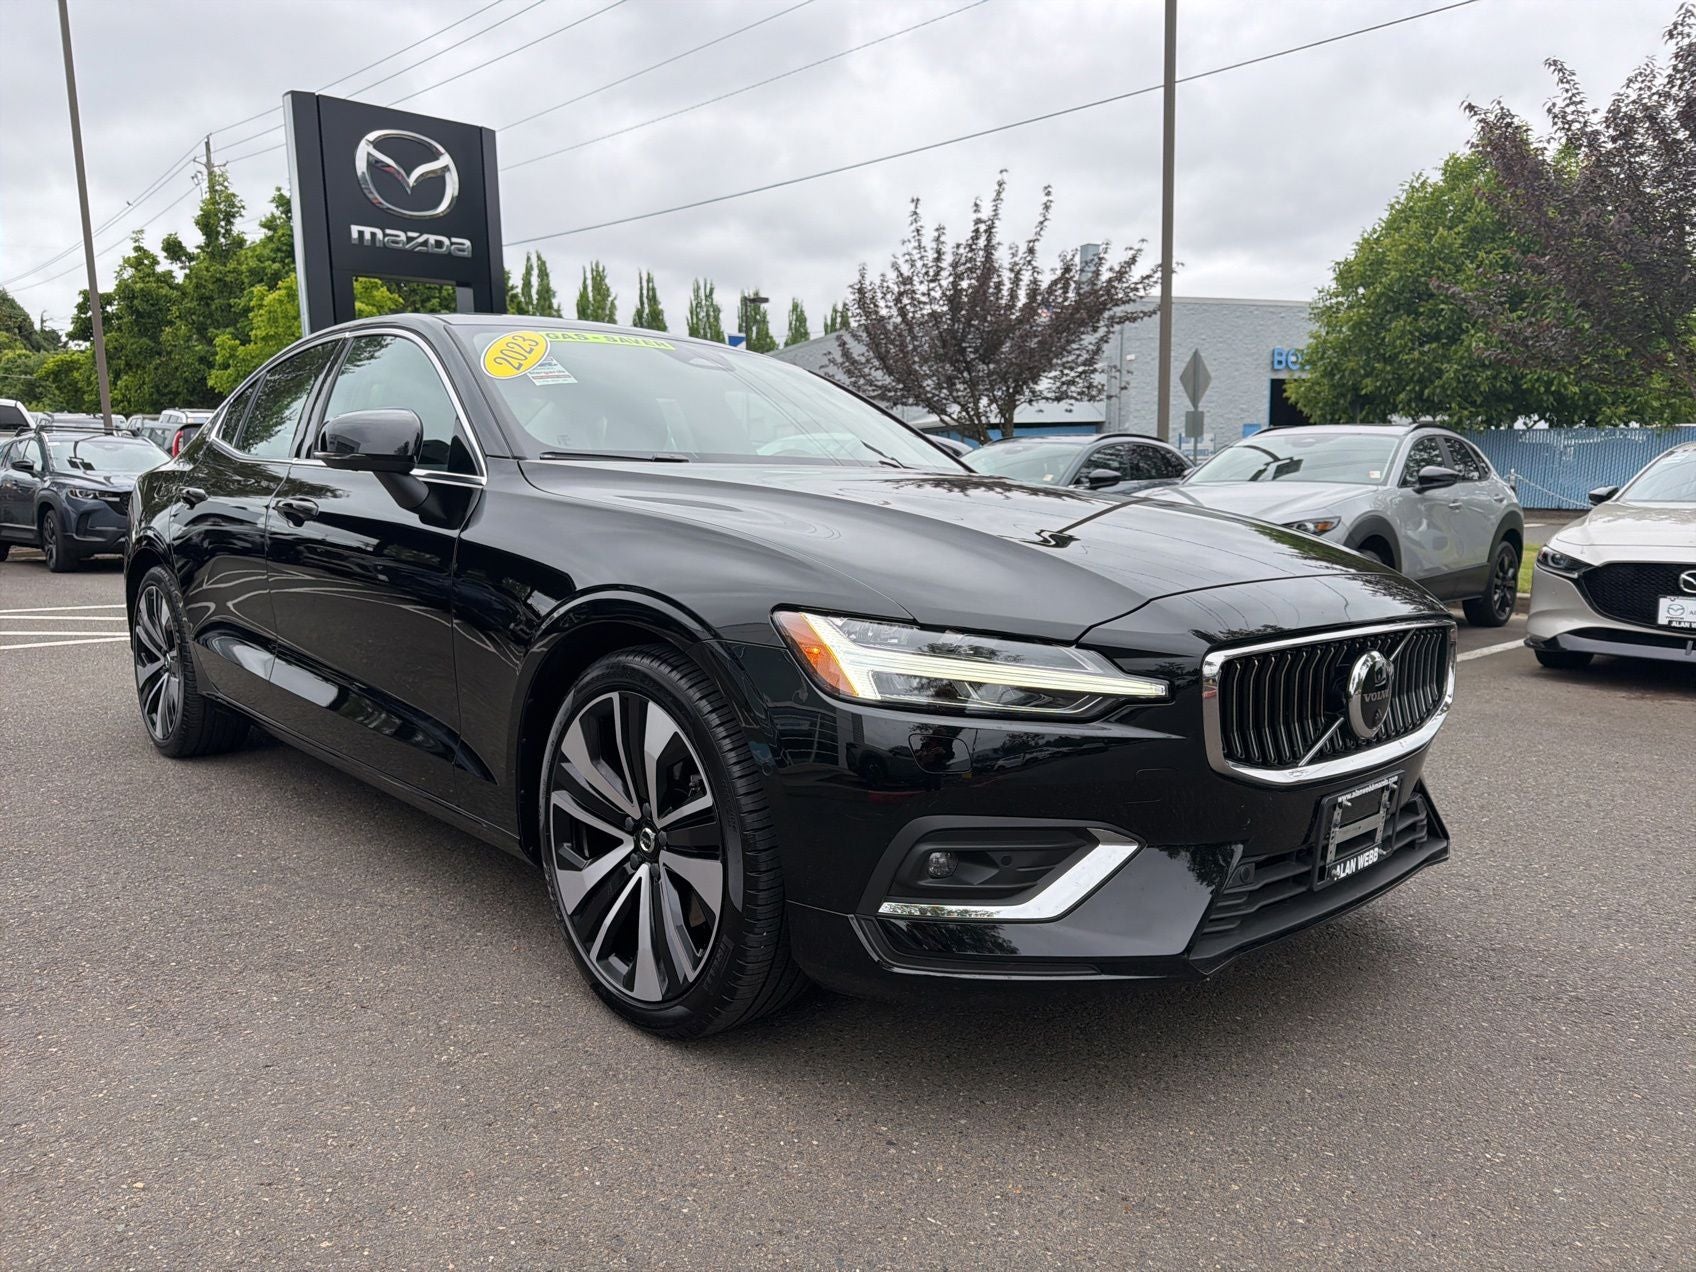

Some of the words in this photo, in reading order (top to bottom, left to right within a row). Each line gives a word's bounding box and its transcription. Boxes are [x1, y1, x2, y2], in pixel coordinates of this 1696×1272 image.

[493, 334, 540, 371] 2023
[1335, 857, 1356, 879] ALAN
[1357, 847, 1379, 870] WEBB
